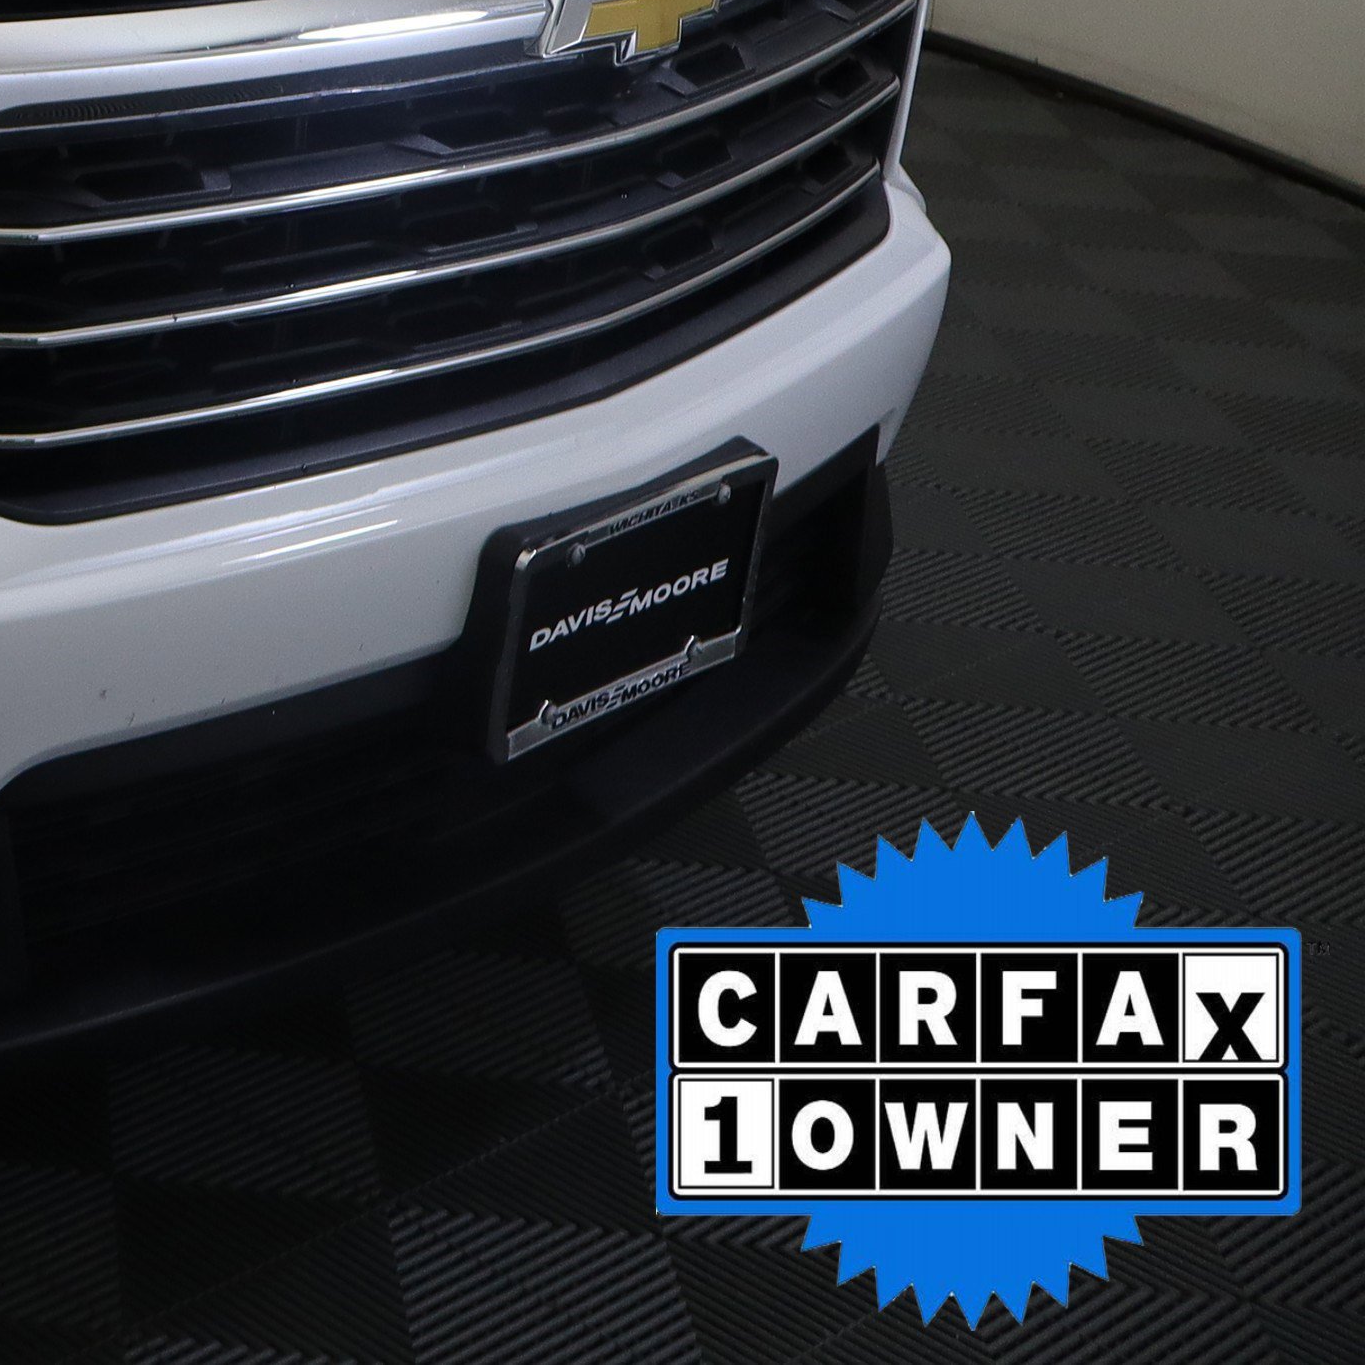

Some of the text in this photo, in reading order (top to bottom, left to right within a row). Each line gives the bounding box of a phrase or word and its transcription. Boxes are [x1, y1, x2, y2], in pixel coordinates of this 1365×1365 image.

[528, 558, 729, 652] DAVIS MOORE
[550, 663, 692, 729] DAVIS MOORE
